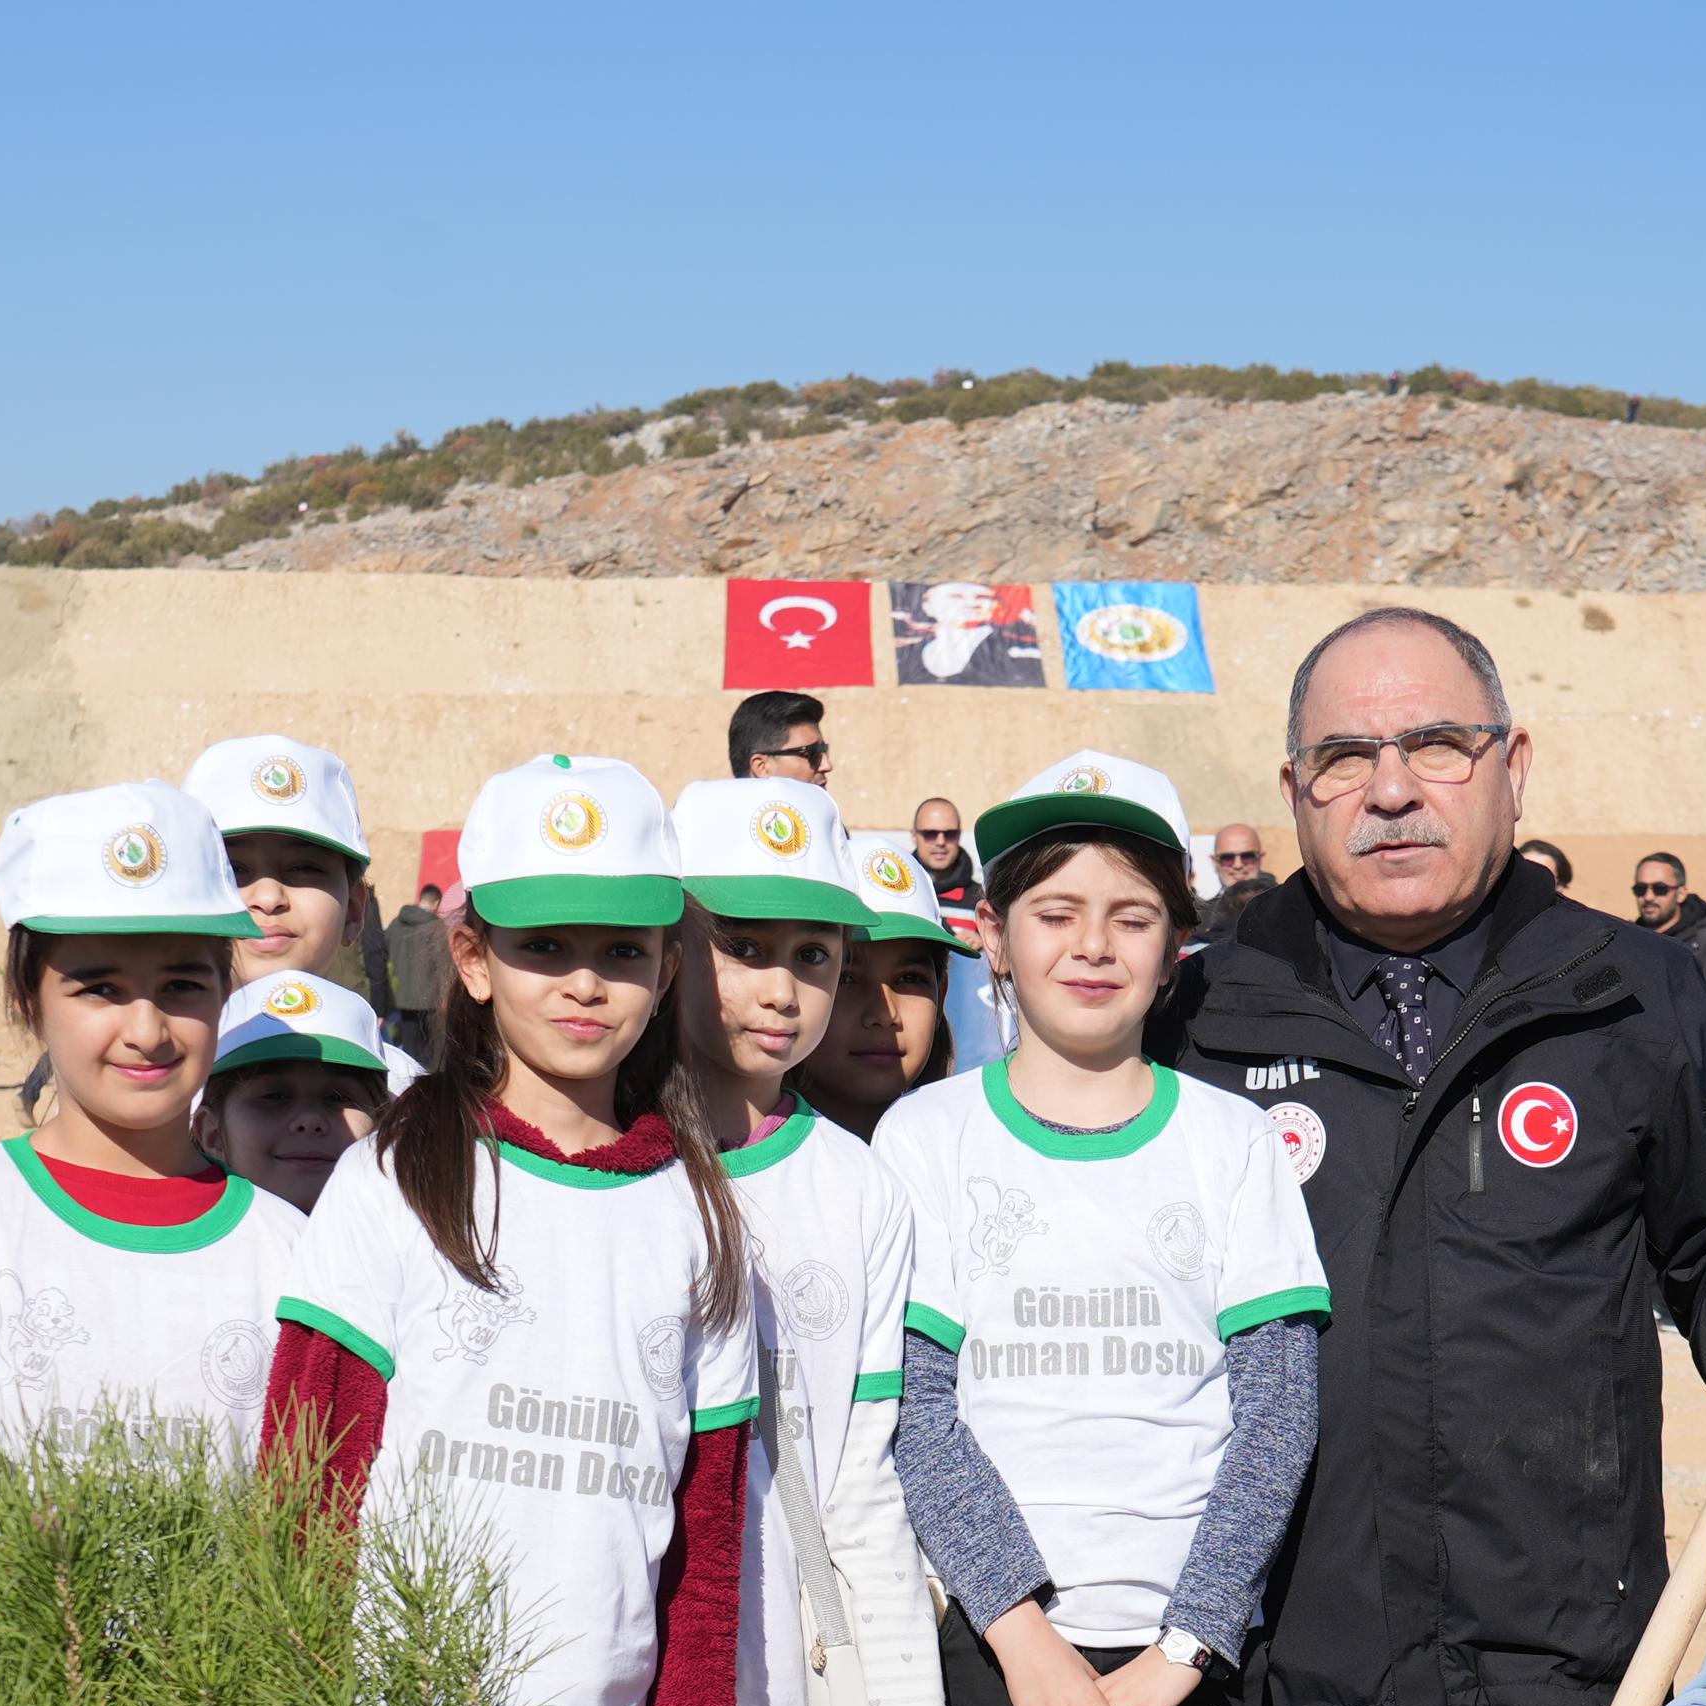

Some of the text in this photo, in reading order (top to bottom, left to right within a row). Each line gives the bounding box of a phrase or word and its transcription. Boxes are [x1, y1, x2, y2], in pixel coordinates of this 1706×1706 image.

[1013, 1286, 1161, 1328] Gönüllü
[468, 1326, 494, 1346] OGM
[969, 1335, 1205, 1381] Orman Dostu
[487, 1383, 640, 1449] Gönüllü
[419, 1429, 671, 1507] Orman Dostu
